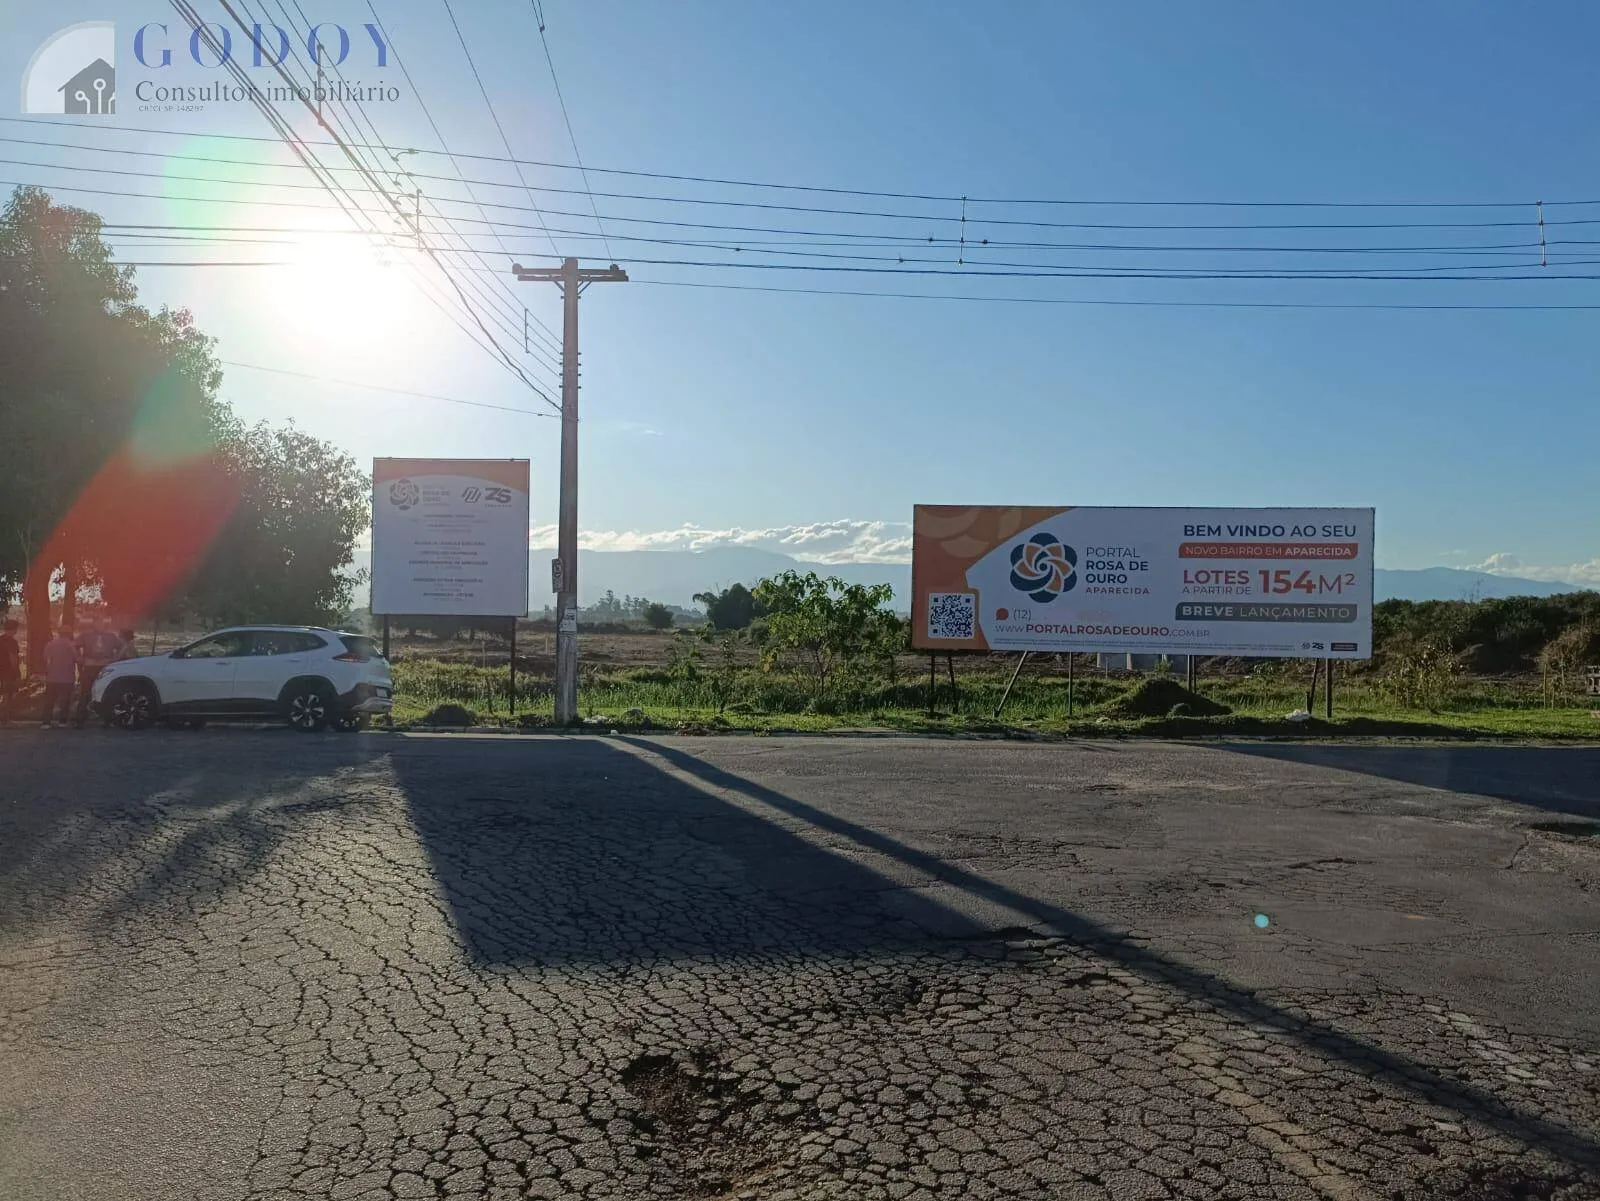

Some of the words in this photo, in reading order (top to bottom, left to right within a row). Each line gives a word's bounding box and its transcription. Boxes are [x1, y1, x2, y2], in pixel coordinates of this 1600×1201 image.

[1184, 525, 1222, 537] BEM
[1227, 525, 1285, 537] VINDO
[1290, 525, 1316, 537] AO
[1321, 525, 1357, 538] SEU
[1085, 547, 1140, 558] PORTAL
[1185, 546, 1219, 555] NOVO
[1221, 546, 1262, 556] BAIRRO
[1264, 547, 1282, 556] EM
[1285, 547, 1352, 556] APARECIDA
[1085, 560, 1125, 571] ROSA
[1129, 561, 1149, 571] DE
[1085, 573, 1127, 584] OURO
[1183, 570, 1250, 585] LOTES
[1085, 587, 1150, 595] APARECIDA
[1182, 586, 1189, 594] A
[1193, 586, 1232, 595] PARTIR
[1235, 586, 1252, 595] DE
[1012, 608, 1032, 621] (12)
[1182, 606, 1234, 617] BREVE
[1240, 607, 1350, 620] LANÇAMENTO
